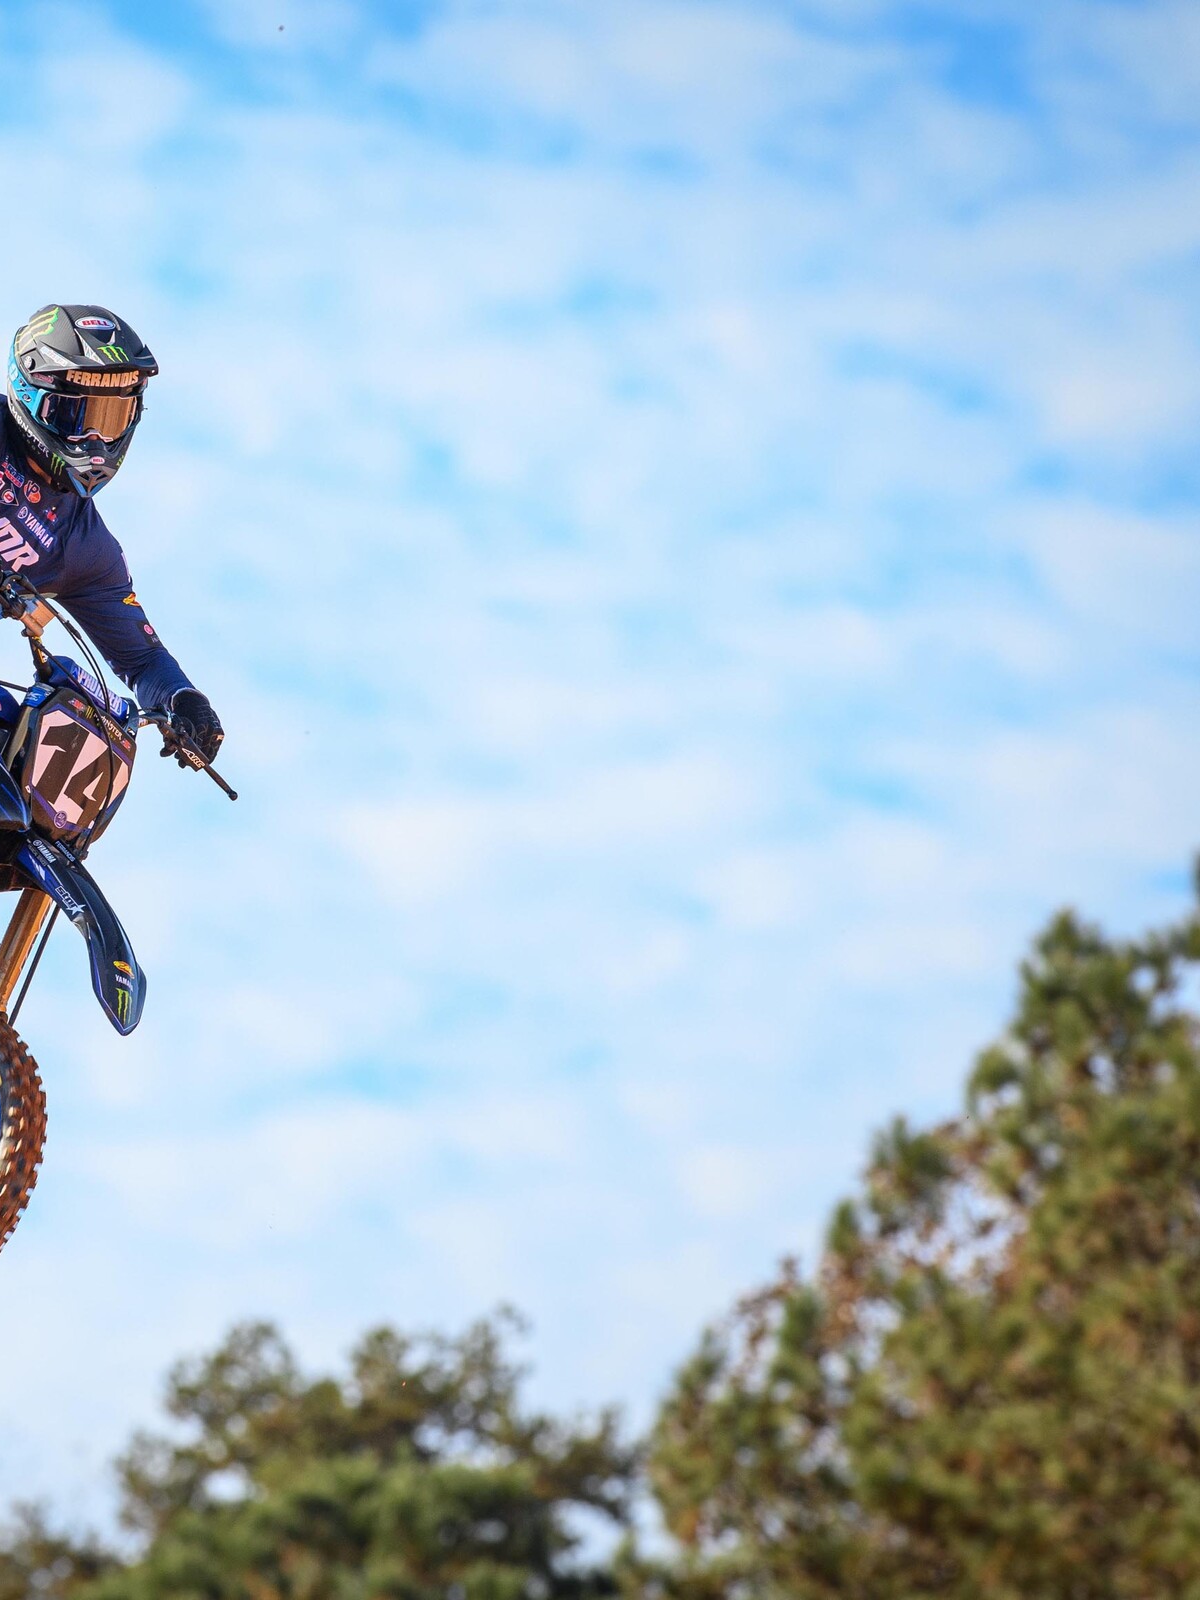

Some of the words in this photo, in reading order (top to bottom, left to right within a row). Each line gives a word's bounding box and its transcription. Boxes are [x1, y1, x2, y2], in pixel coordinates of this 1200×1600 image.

[81, 319, 109, 327] BELL
[66, 369, 139, 387] FERRANDIS
[36, 722, 123, 824] 14
[37, 843, 57, 864] YAMAHA
